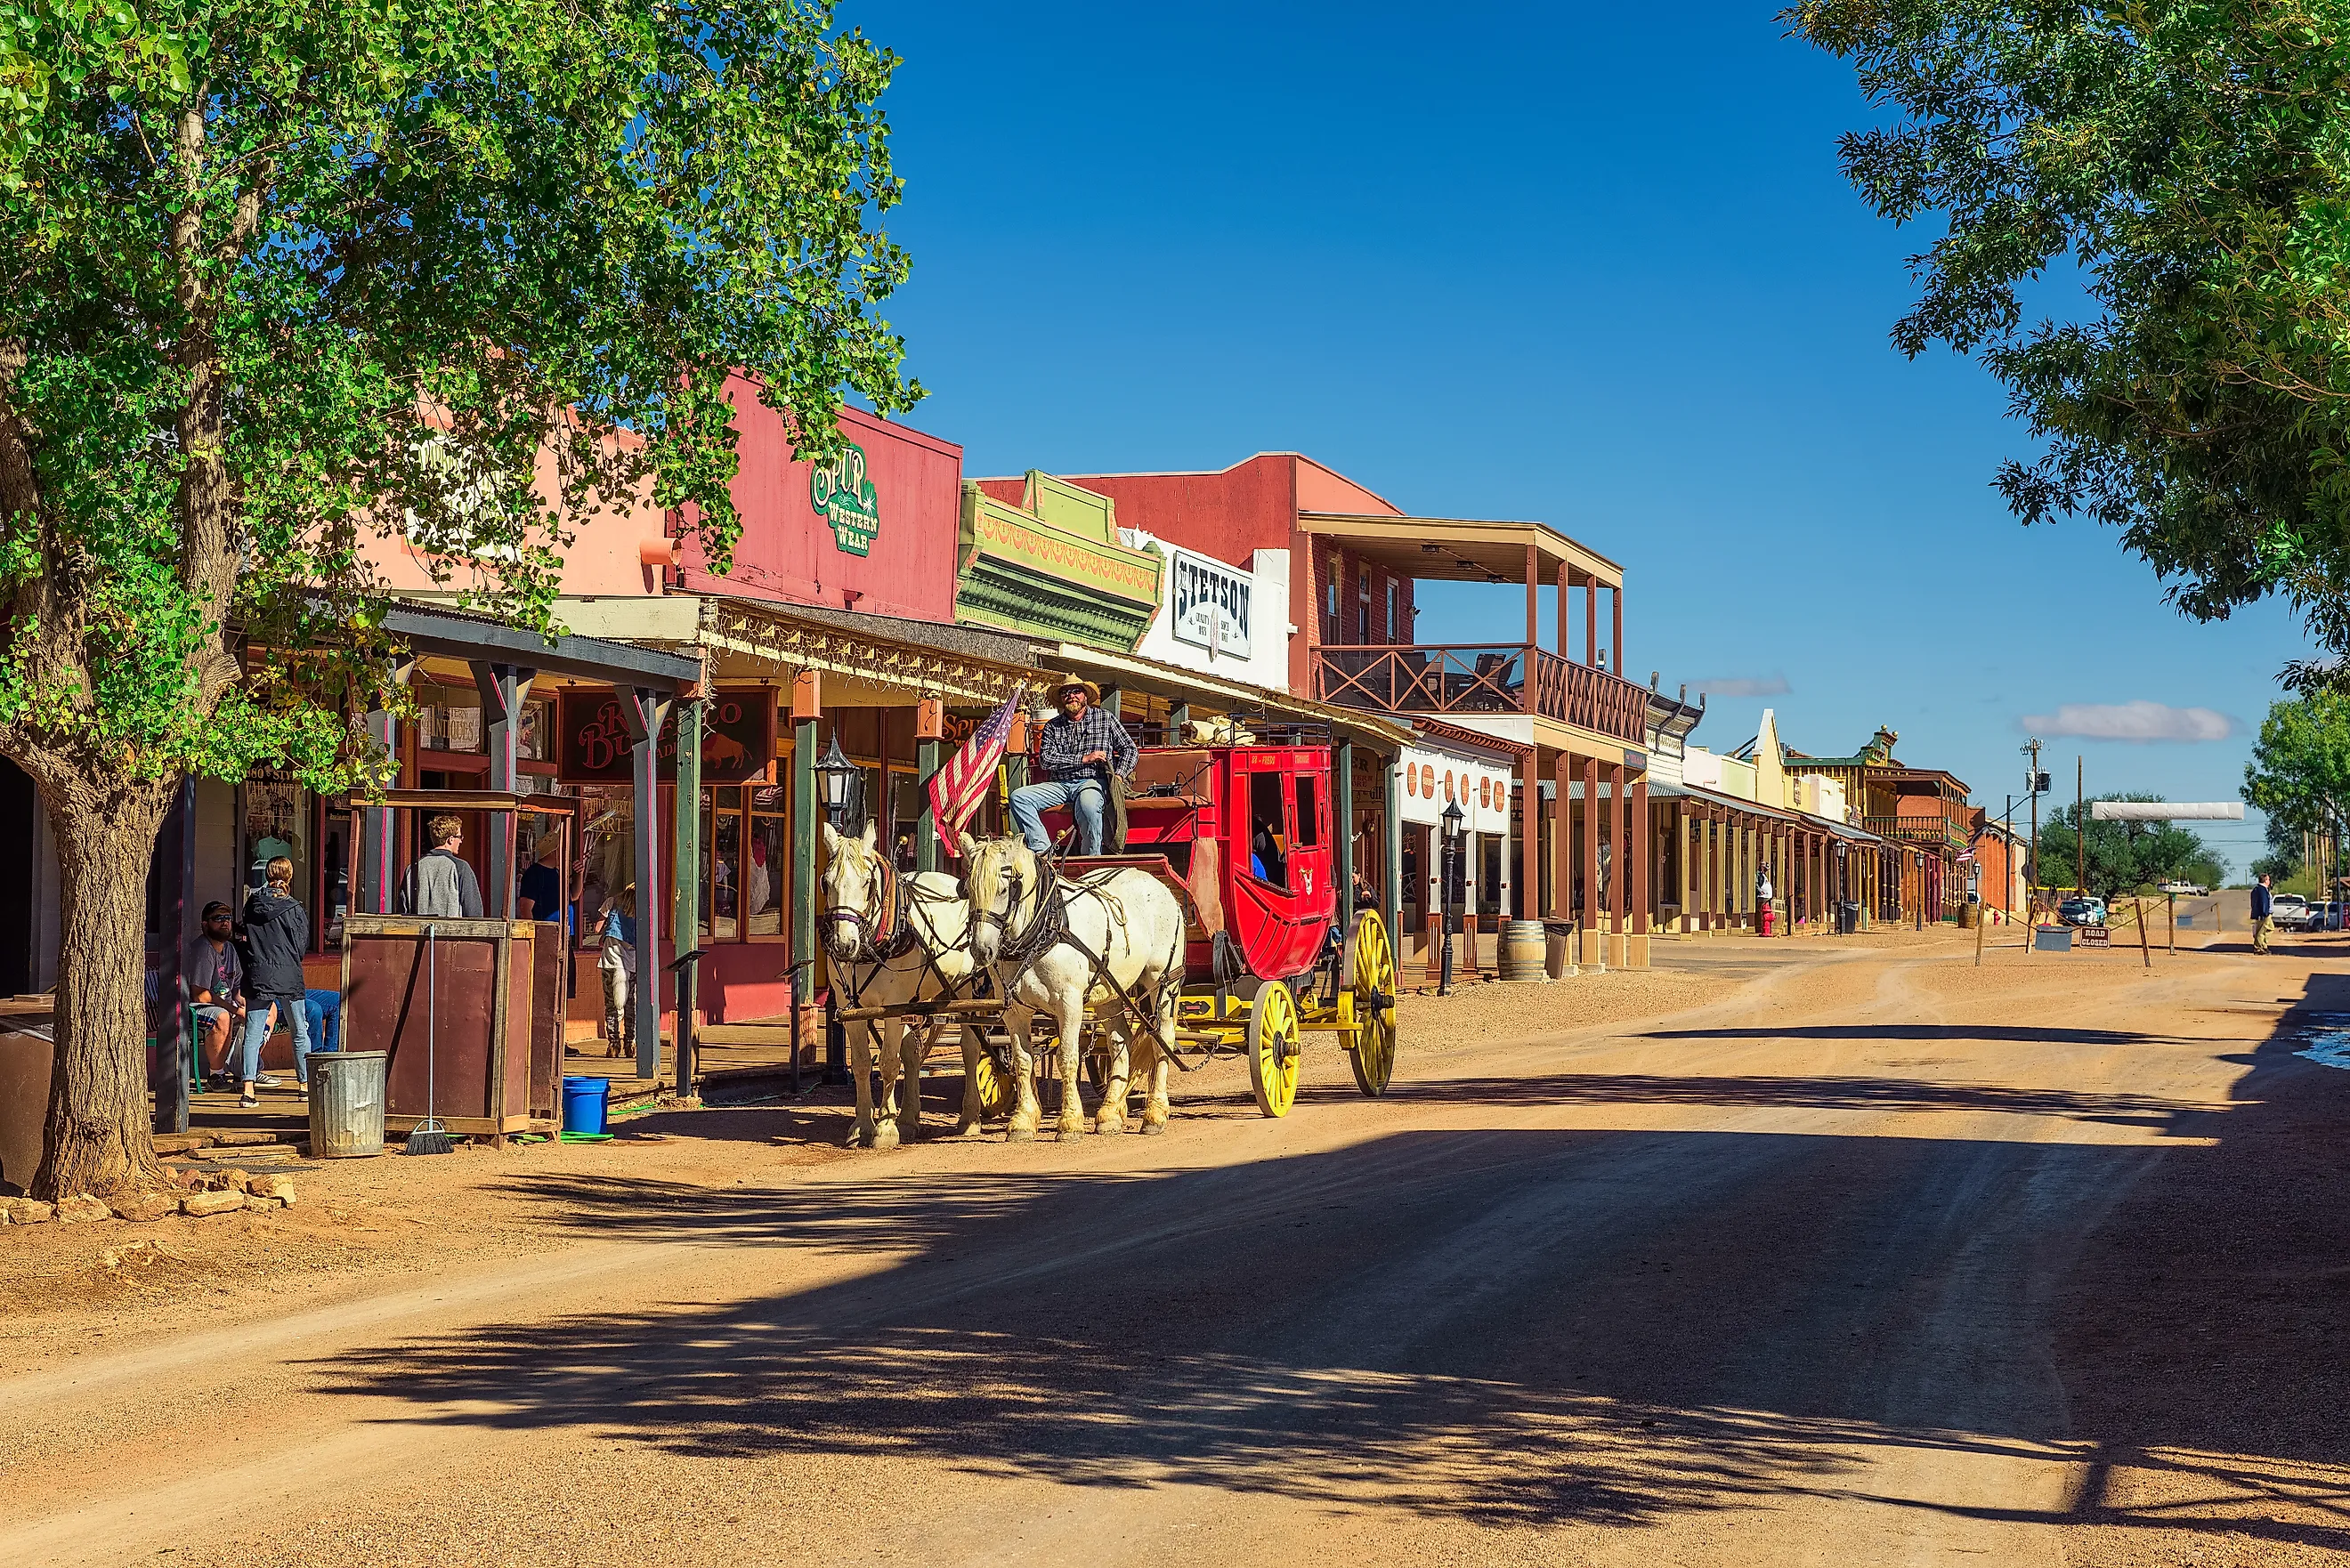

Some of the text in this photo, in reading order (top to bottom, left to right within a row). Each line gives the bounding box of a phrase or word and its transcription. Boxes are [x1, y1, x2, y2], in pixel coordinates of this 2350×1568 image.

[814, 447, 864, 508] SPUR
[829, 502, 879, 533] WESTERN
[838, 525, 869, 550] WEAR
[1179, 560, 1250, 642] STETSON
[426, 704, 474, 741] ANTIQUES
[436, 700, 469, 719] WESTERN
[942, 714, 983, 741] SPU
[596, 818, 624, 835] ART
[2082, 938, 2108, 947] CLOSED
[2085, 929, 2106, 938] ROAD
